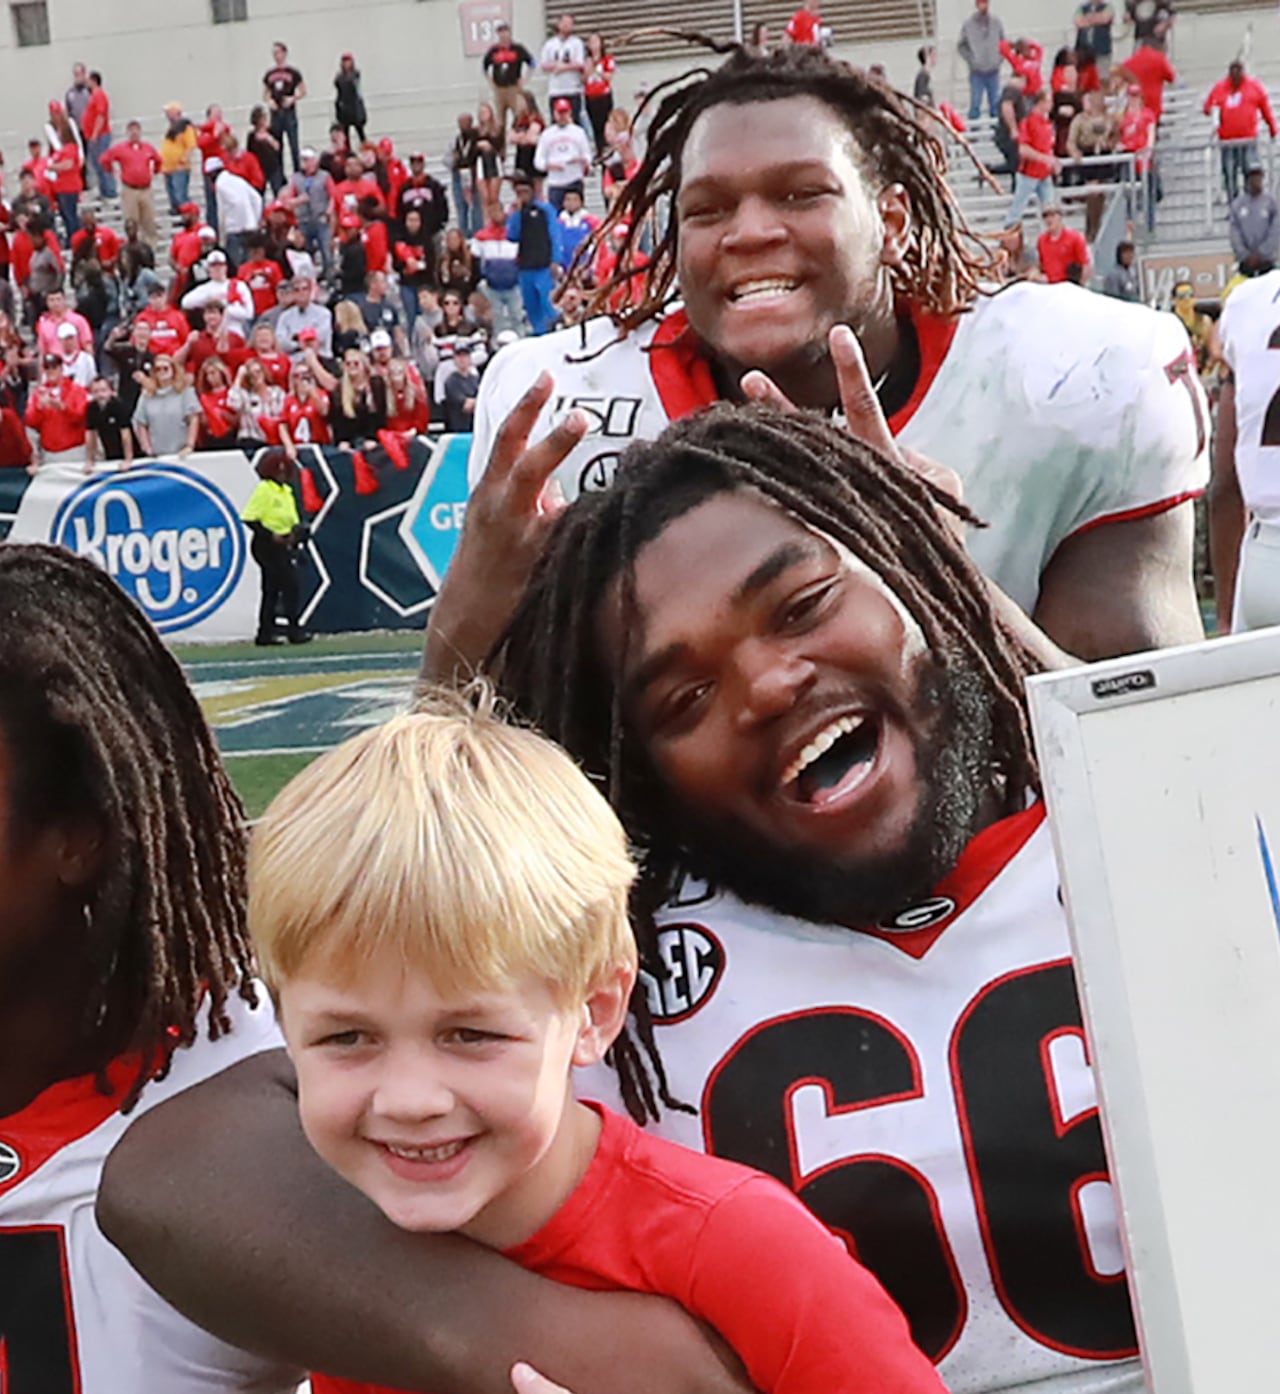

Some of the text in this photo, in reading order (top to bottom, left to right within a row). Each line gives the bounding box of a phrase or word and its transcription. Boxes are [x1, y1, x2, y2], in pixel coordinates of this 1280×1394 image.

[471, 19, 508, 42] 13
[73, 489, 227, 611] Kroger
[701, 957, 1141, 1365] 66
